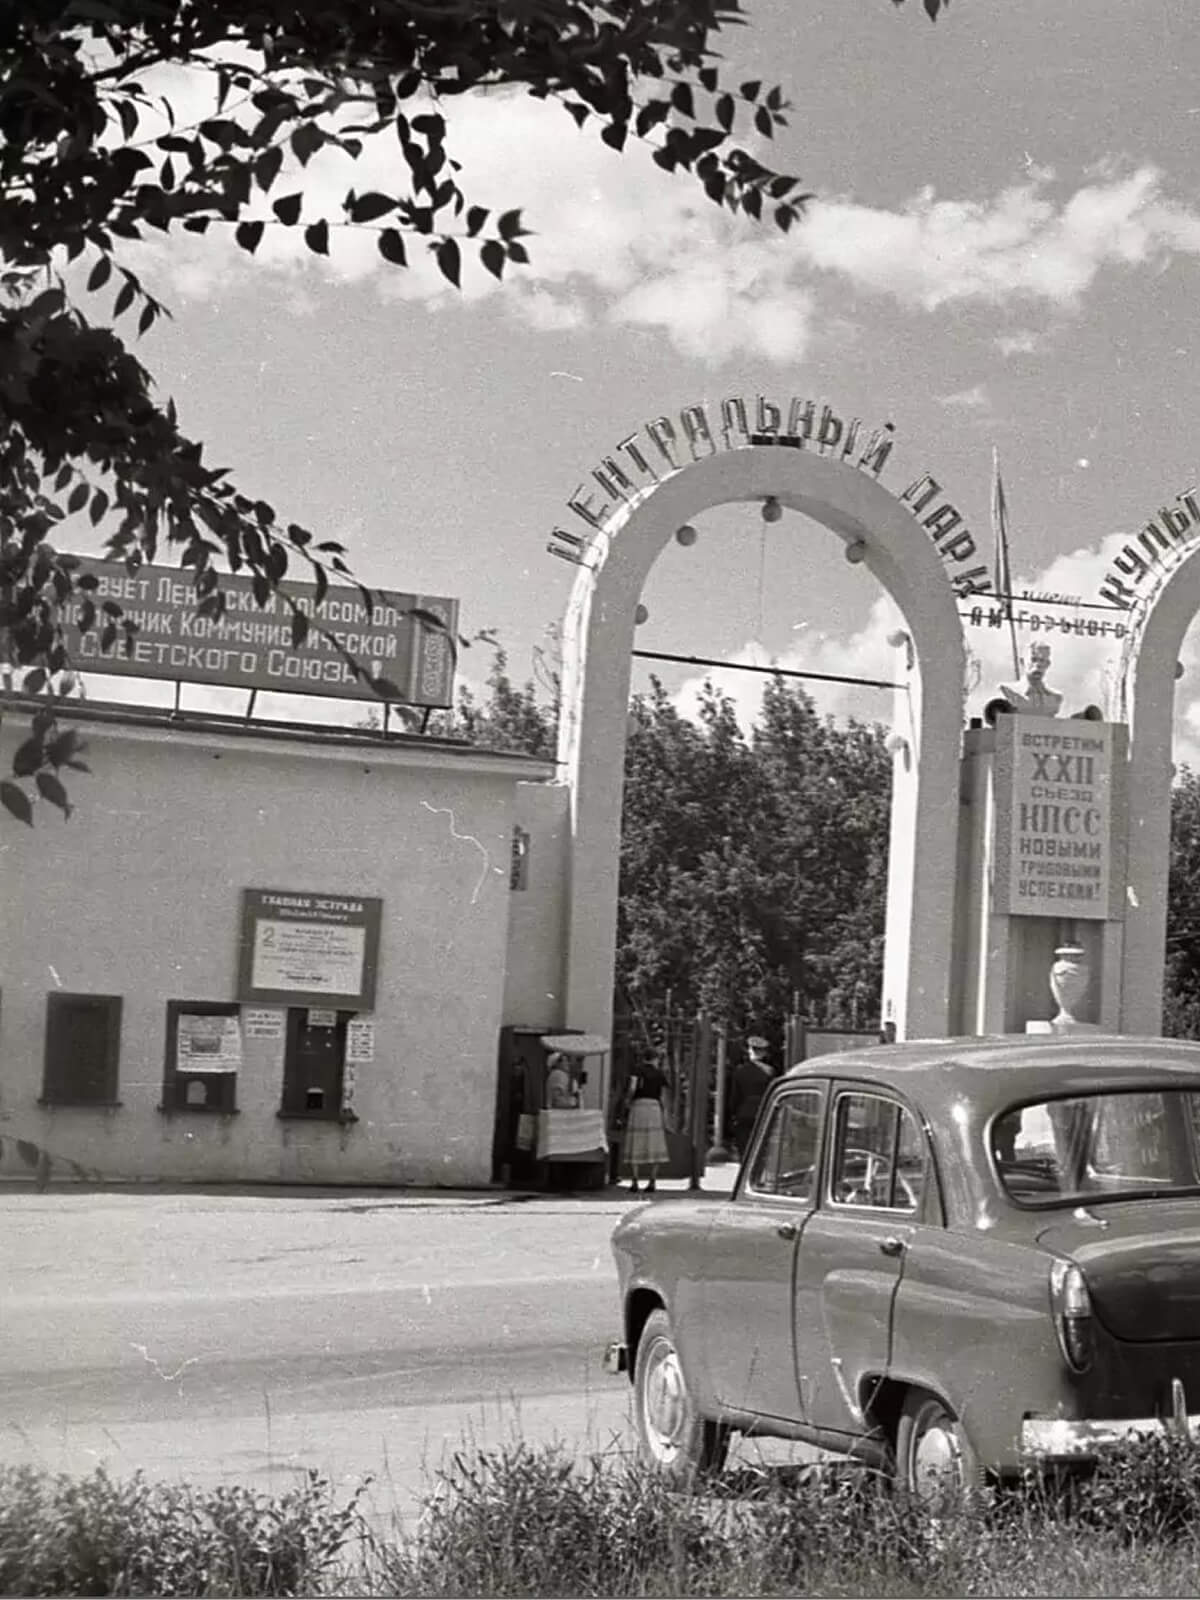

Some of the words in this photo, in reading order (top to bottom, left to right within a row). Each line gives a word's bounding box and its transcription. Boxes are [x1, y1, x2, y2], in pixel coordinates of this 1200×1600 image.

[546, 395, 894, 569] ЦЕНТРАЛЬНЫЙ
[900, 473, 993, 599] ПАРК
[180, 611, 398, 658] КОММУНИСИЧЕСКОЙ
[1019, 837, 1102, 860] НОВЫМИ
